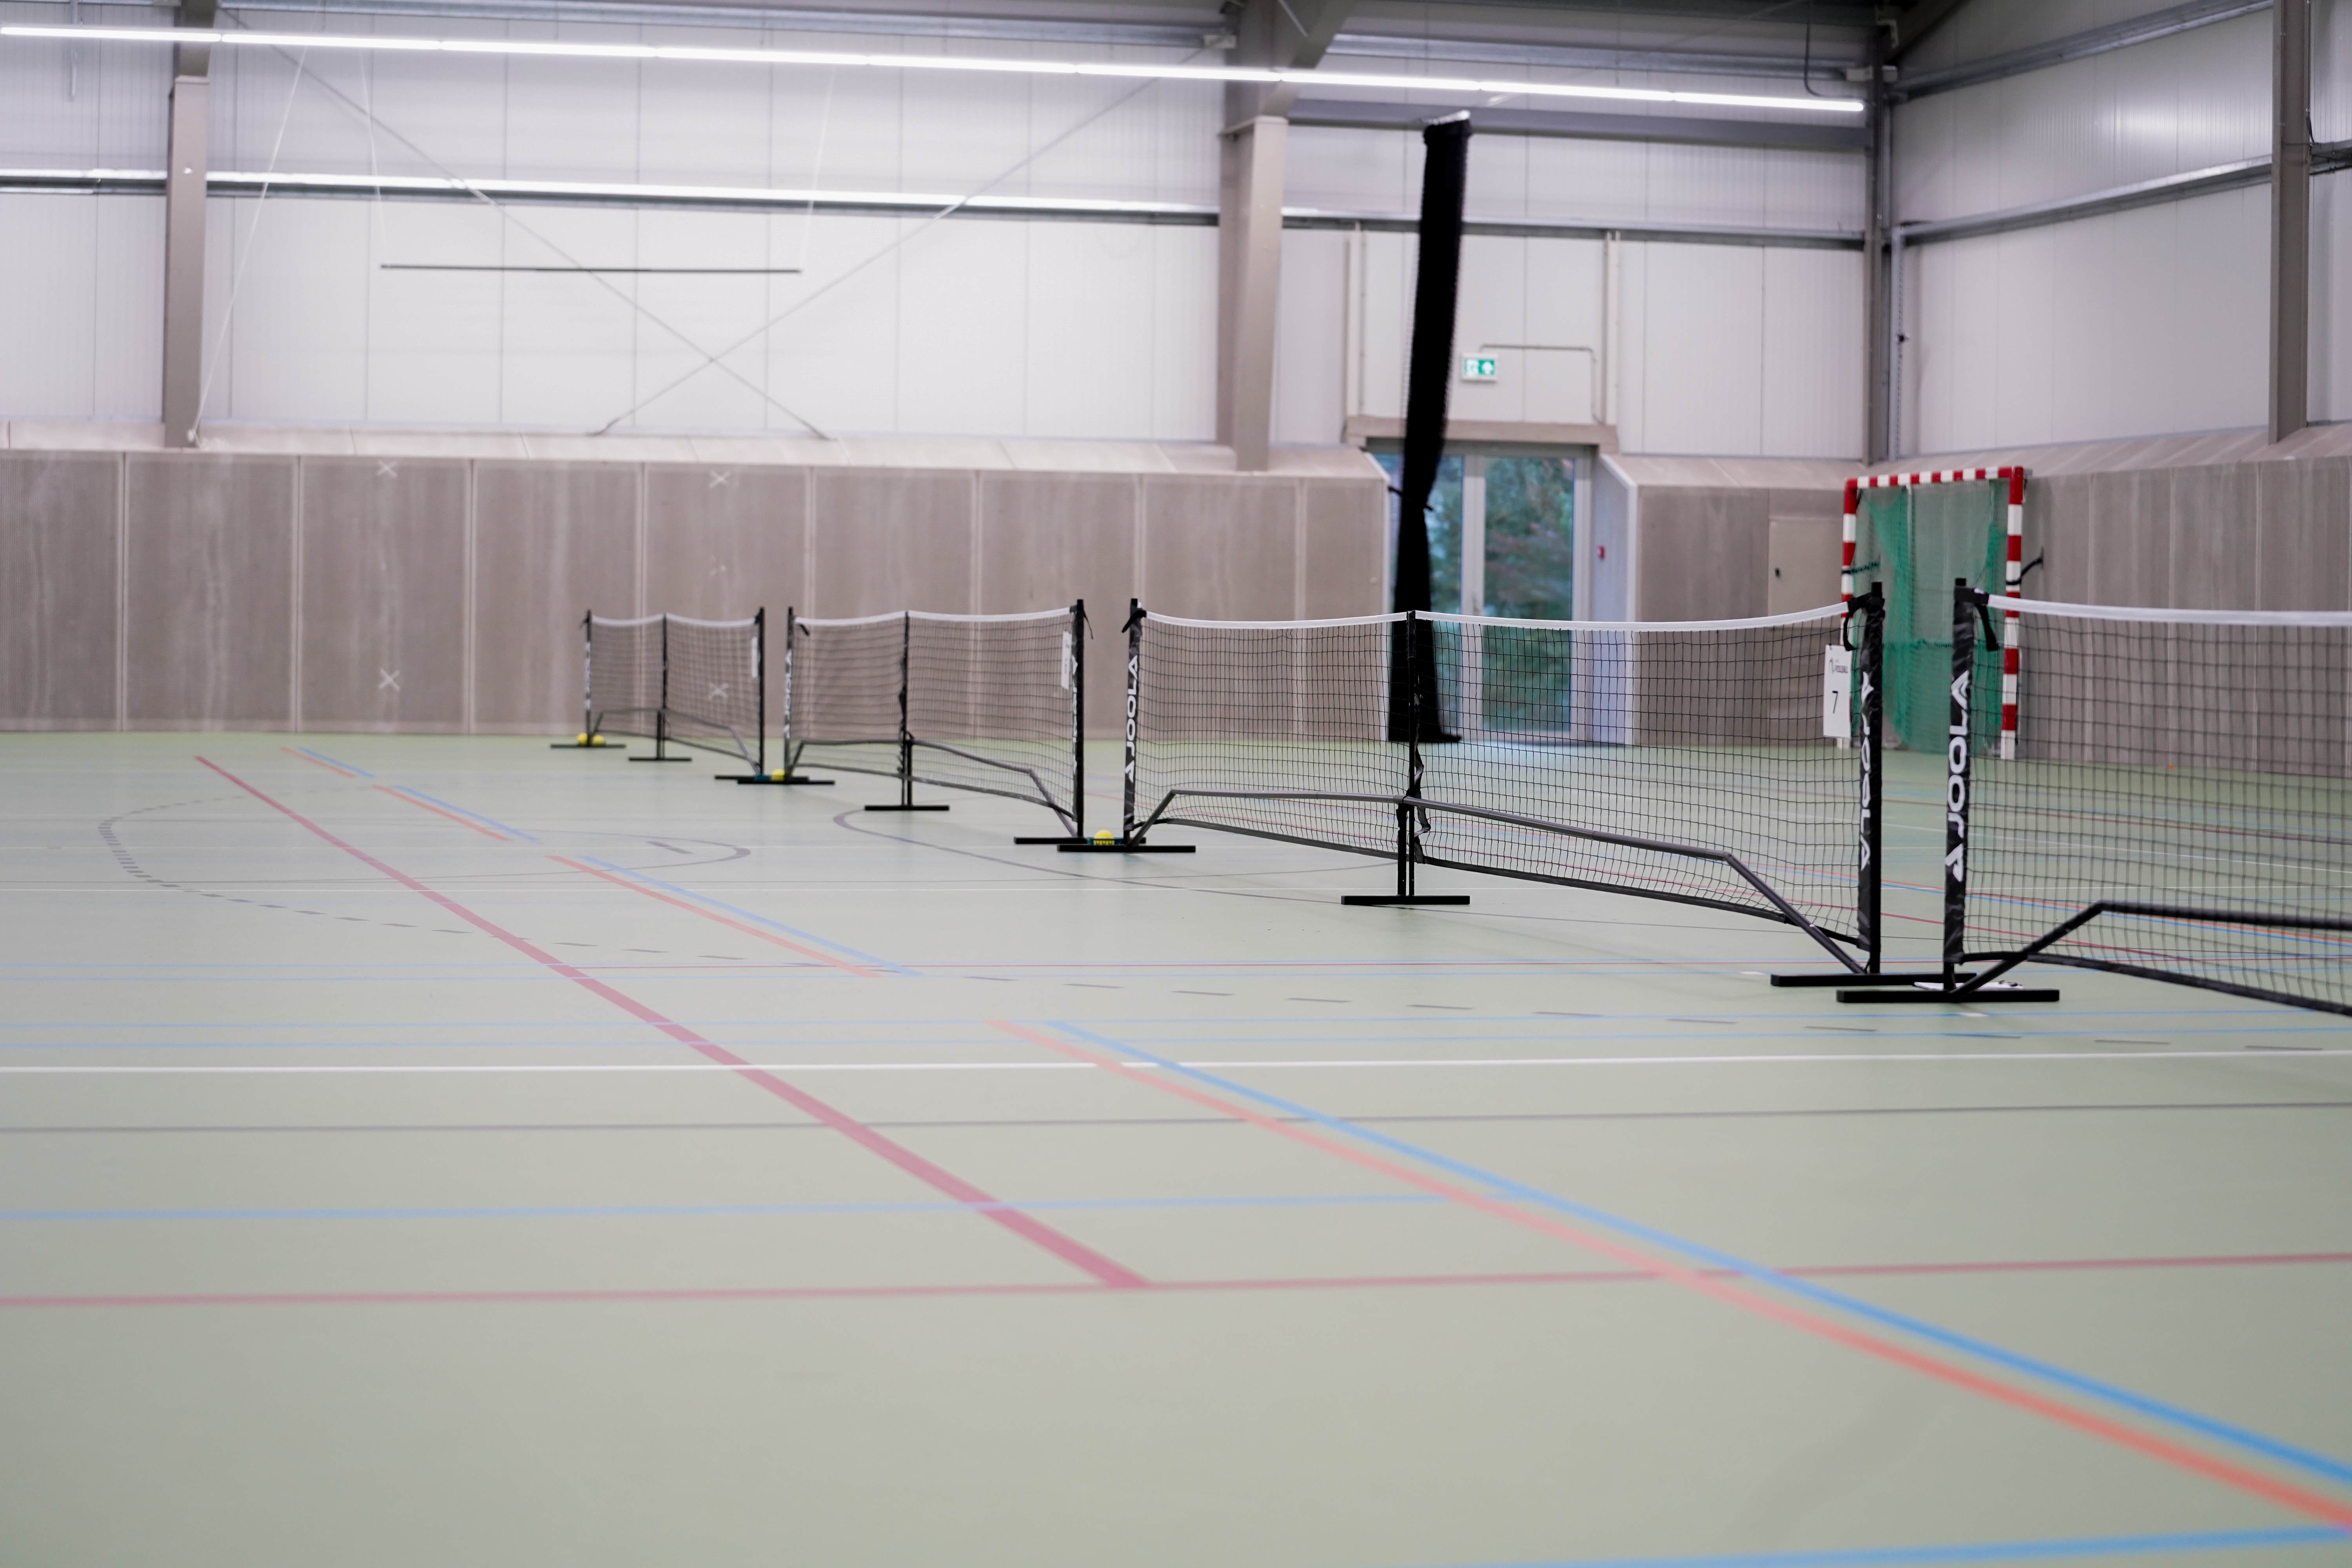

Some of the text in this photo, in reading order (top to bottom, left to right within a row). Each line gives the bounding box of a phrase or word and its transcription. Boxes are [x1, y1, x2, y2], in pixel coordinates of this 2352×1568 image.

[1127, 655, 1138, 757] JOOLA
[1832, 690, 1838, 713] 7
[1947, 670, 1969, 839] JOOLA
